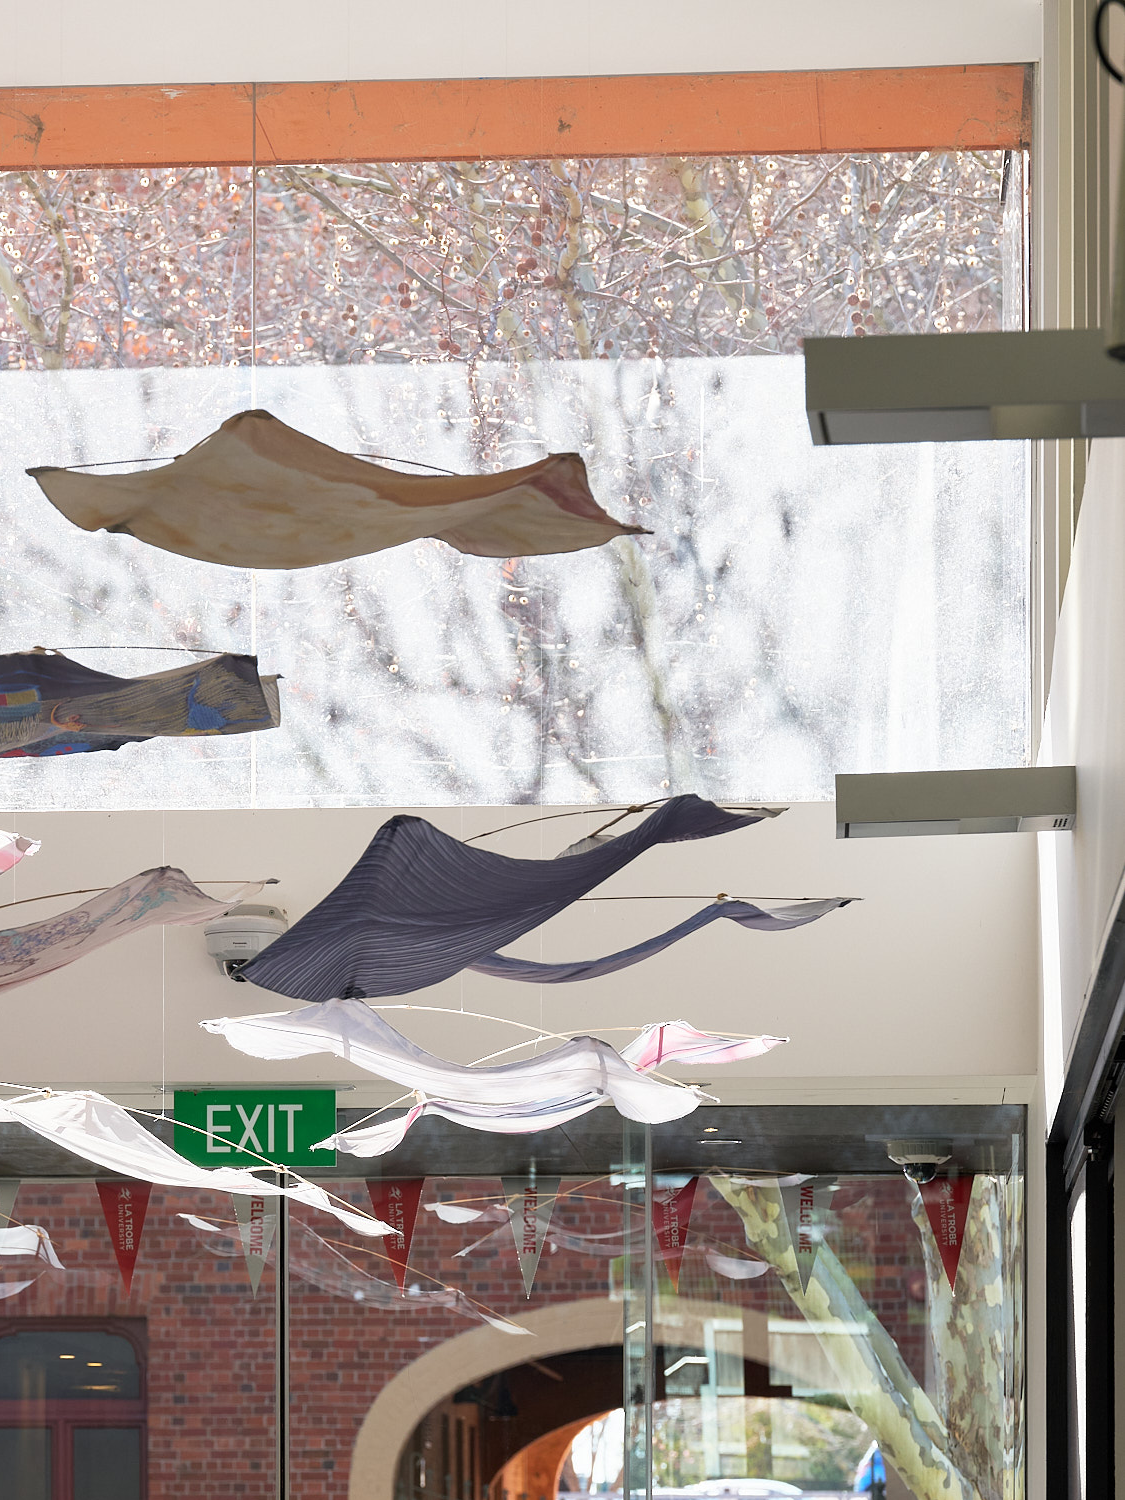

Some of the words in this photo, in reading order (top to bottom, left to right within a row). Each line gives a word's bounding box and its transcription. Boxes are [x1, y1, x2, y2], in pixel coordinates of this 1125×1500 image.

[206, 1104, 303, 1153] EXIT
[124, 1203, 133, 1217] LA
[395, 1203, 404, 1216] LA
[523, 1186, 538, 1255] WELCOME
[670, 1200, 677, 1214] LA
[799, 1185, 814, 1254] WELCOME
[946, 1199, 955, 1212] LA
[125, 1218, 134, 1251] TROBE
[671, 1215, 680, 1248] TROBE
[940, 1200, 948, 1246] UNIVERSITY
[948, 1213, 957, 1246] TROBE
